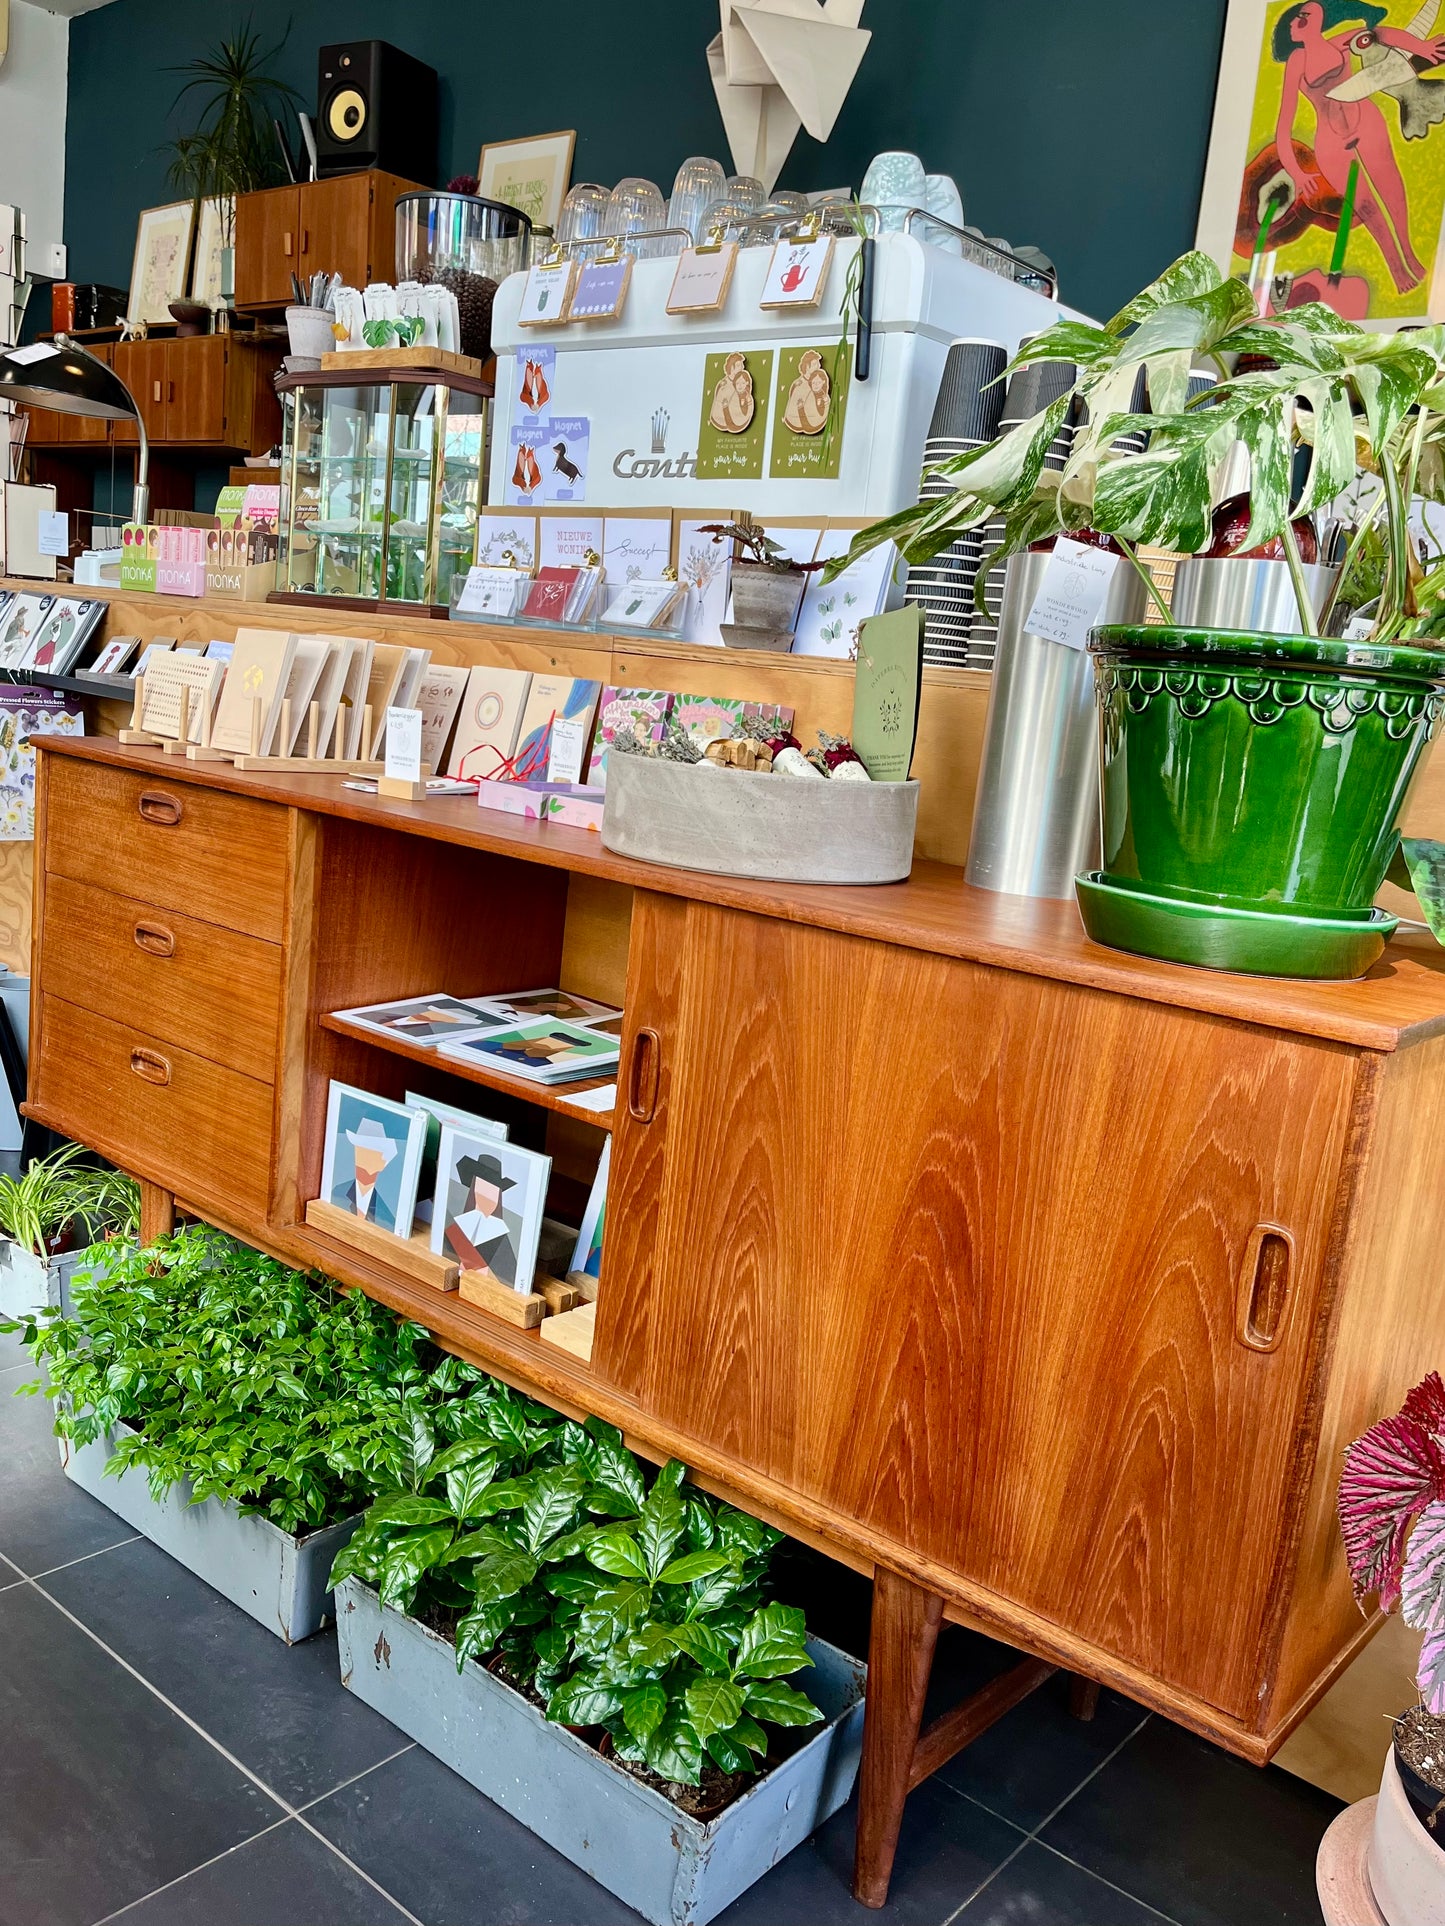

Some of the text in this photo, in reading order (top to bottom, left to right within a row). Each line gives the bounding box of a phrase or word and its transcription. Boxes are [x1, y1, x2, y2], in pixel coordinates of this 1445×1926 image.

[520, 347, 548, 360] Magnet
[554, 420, 582, 433] Magnet
[516, 429, 543, 442] Magnet
[713, 450, 748, 468] your hug
[787, 453, 807, 467] your
[557, 531, 592, 542] NIEUWE
